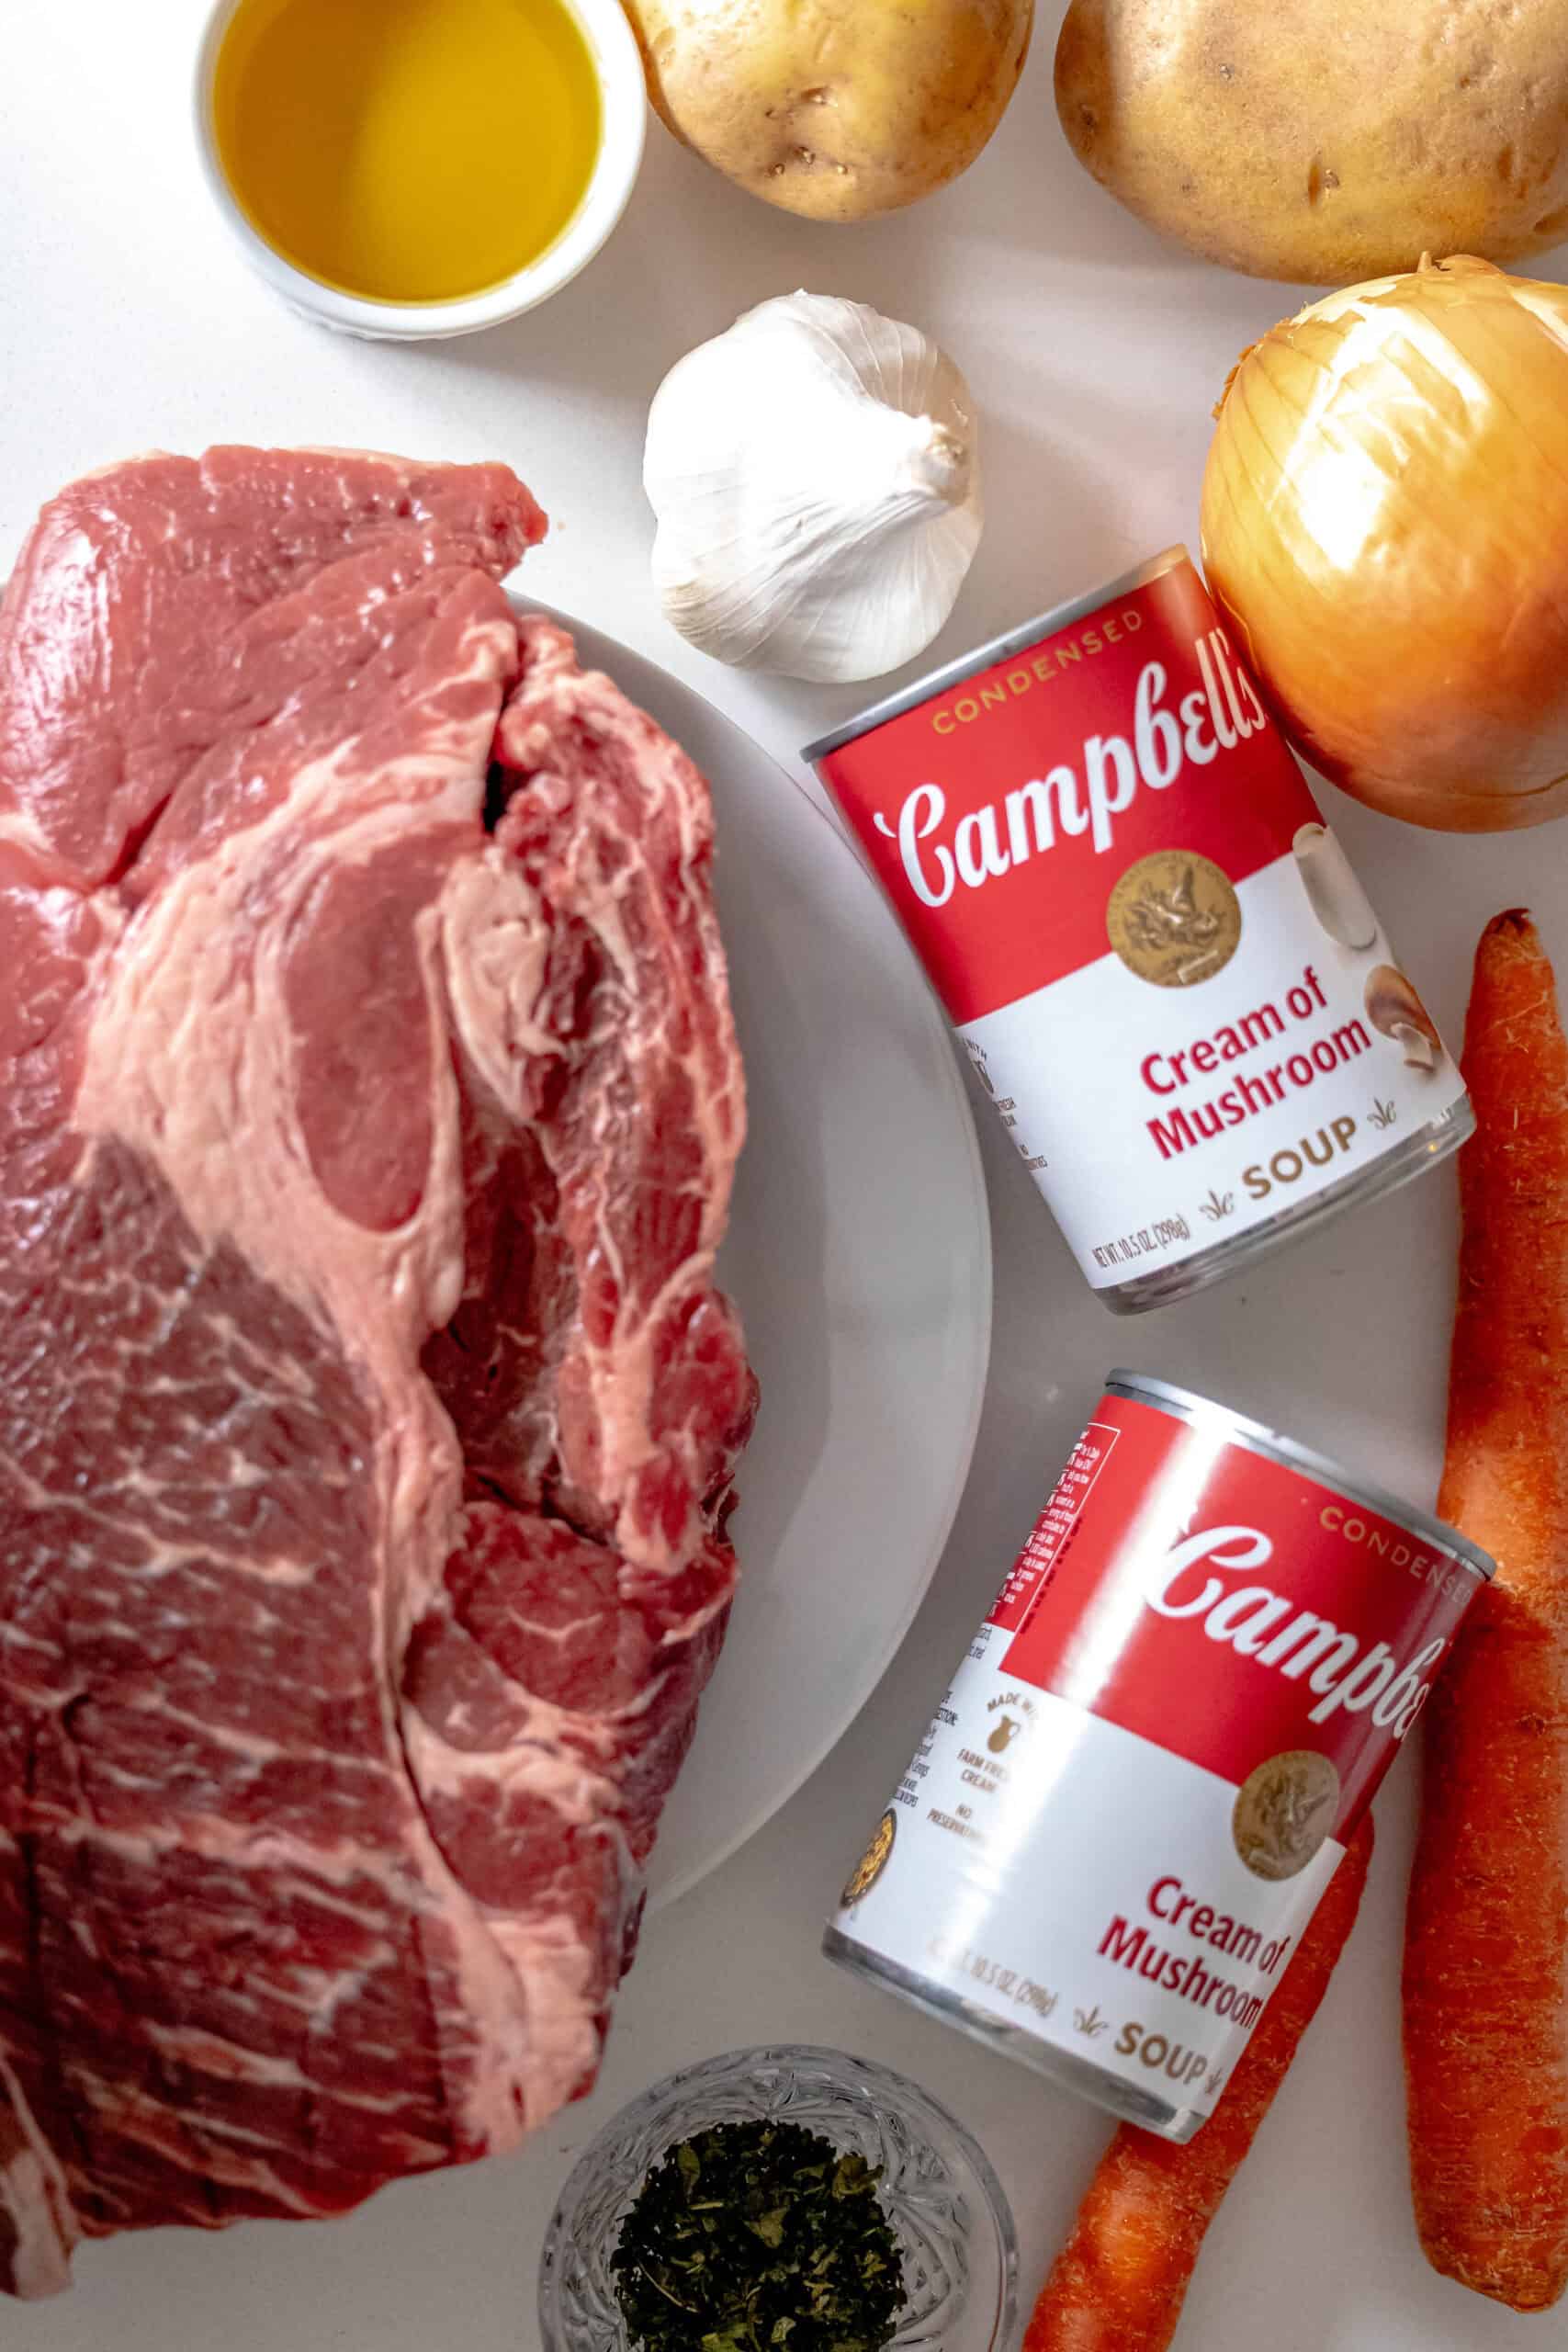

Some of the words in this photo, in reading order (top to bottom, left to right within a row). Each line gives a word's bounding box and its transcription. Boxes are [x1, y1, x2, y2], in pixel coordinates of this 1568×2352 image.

[931, 610, 1142, 735] CONDENSED
[873, 627, 1266, 908] Campbell's
[1140, 1002, 1286, 1096] Cream
[1286, 965, 1327, 1020] of
[1145, 1019, 1372, 1159] Mushroom
[1242, 1115, 1357, 1200] SOUP
[1097, 1914, 1264, 2030] Mushroom
[1146, 1875, 1263, 1965] Cream
[1258, 1935, 1292, 1975] of
[1114, 2021, 1209, 2086] SOUP
